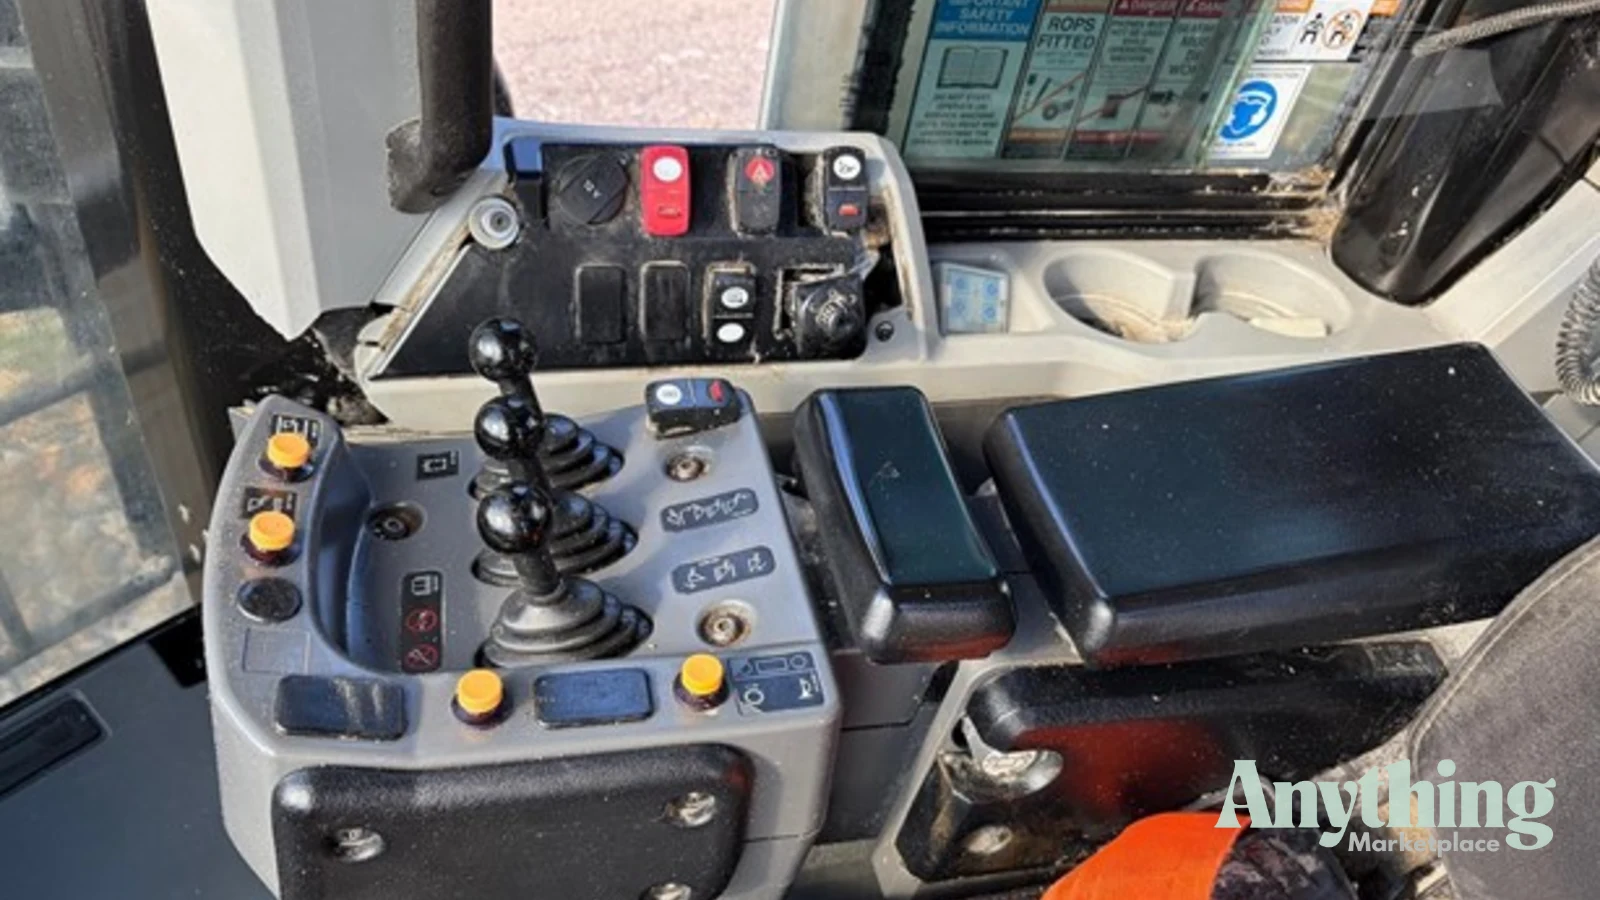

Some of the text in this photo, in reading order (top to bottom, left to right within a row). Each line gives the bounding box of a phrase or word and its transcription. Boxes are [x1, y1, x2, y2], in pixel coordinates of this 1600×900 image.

[959, 8, 1014, 20] SAFETY
[935, 22, 1031, 35] INFORMATION
[1047, 16, 1096, 31] ROPS
[1036, 34, 1096, 50] FITTED
